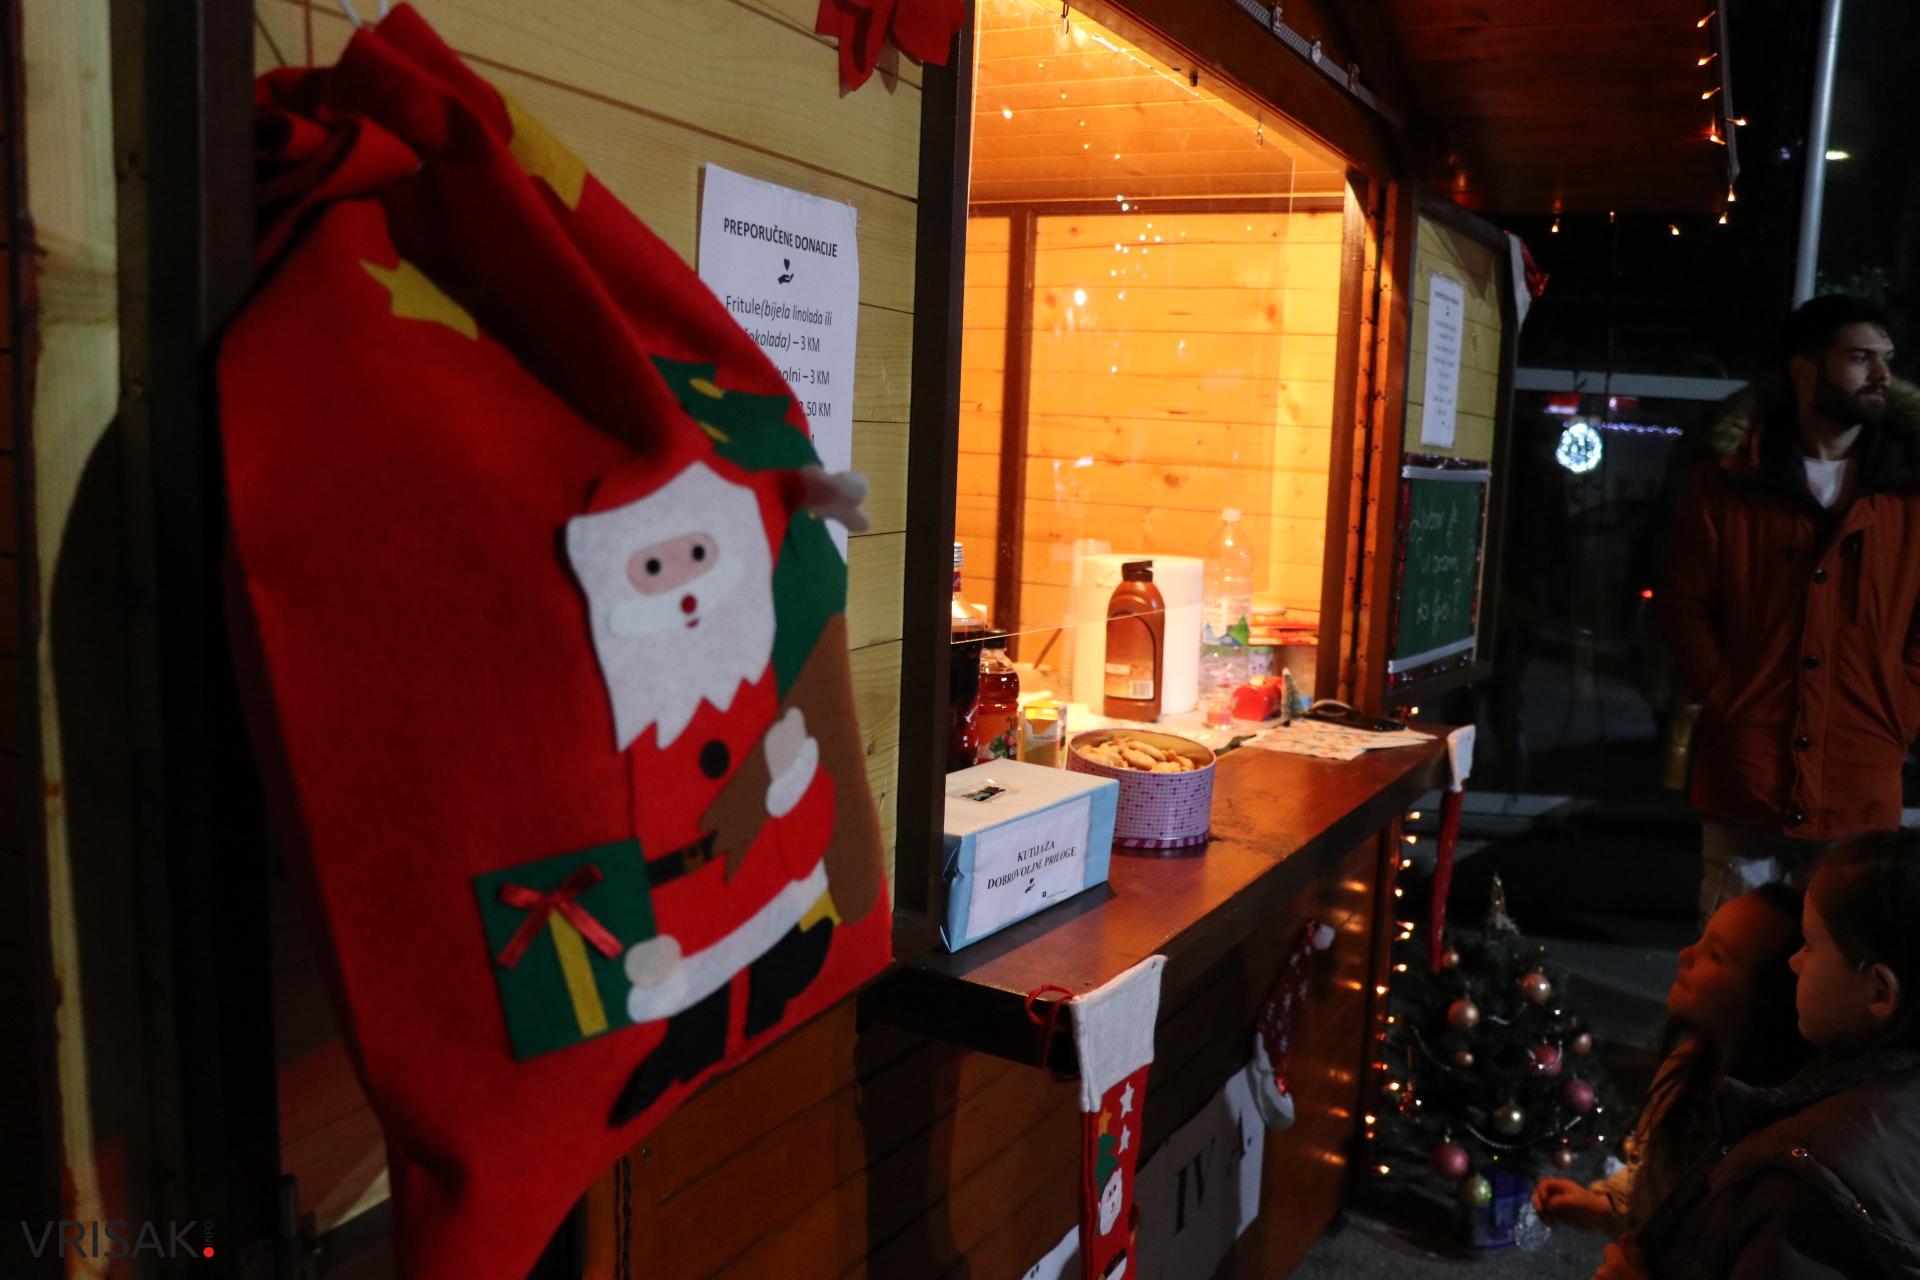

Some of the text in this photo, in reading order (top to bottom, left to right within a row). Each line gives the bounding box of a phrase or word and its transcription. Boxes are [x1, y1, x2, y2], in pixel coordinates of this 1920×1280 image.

[723, 217, 838, 257] PREPORUČENE DONACIJE
[792, 304, 823, 325] linolada
[824, 311, 833, 327] ili
[800, 335, 806, 351] 3
[807, 337, 820, 353] KM
[810, 369, 815, 385] 3
[816, 370, 830, 386] KM
[818, 402, 831, 417] KM
[987, 846, 1076, 889] DOBROVOLJNE PRILOGE
